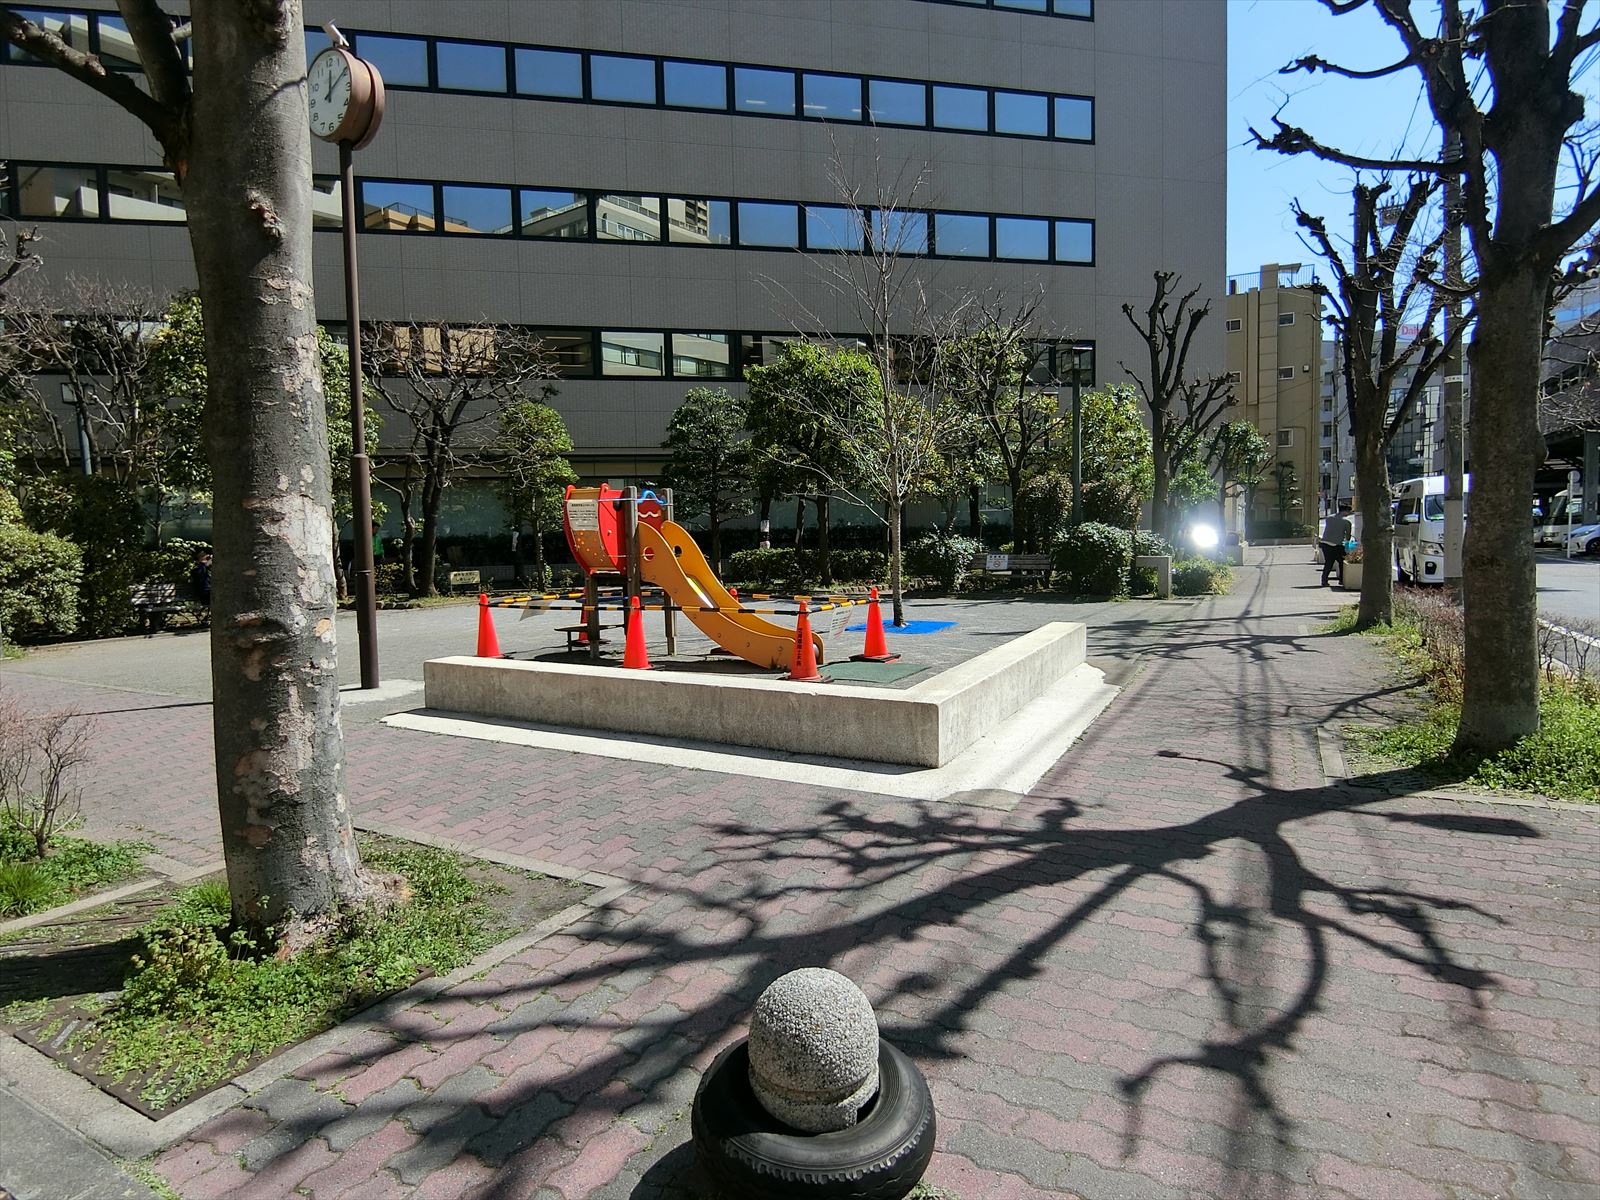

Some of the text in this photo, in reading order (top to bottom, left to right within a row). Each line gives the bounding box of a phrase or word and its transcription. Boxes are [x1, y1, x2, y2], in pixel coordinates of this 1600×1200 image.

[326, 58, 333, 68] 12
[312, 83, 319, 93] 10
[346, 82, 351, 92] 3
[311, 99, 316, 108] 9
[344, 98, 349, 106] 4
[313, 112, 319, 122] 8
[338, 113, 343, 122] 5
[320, 122, 325, 131] 7
[328, 122, 334, 132] 6
